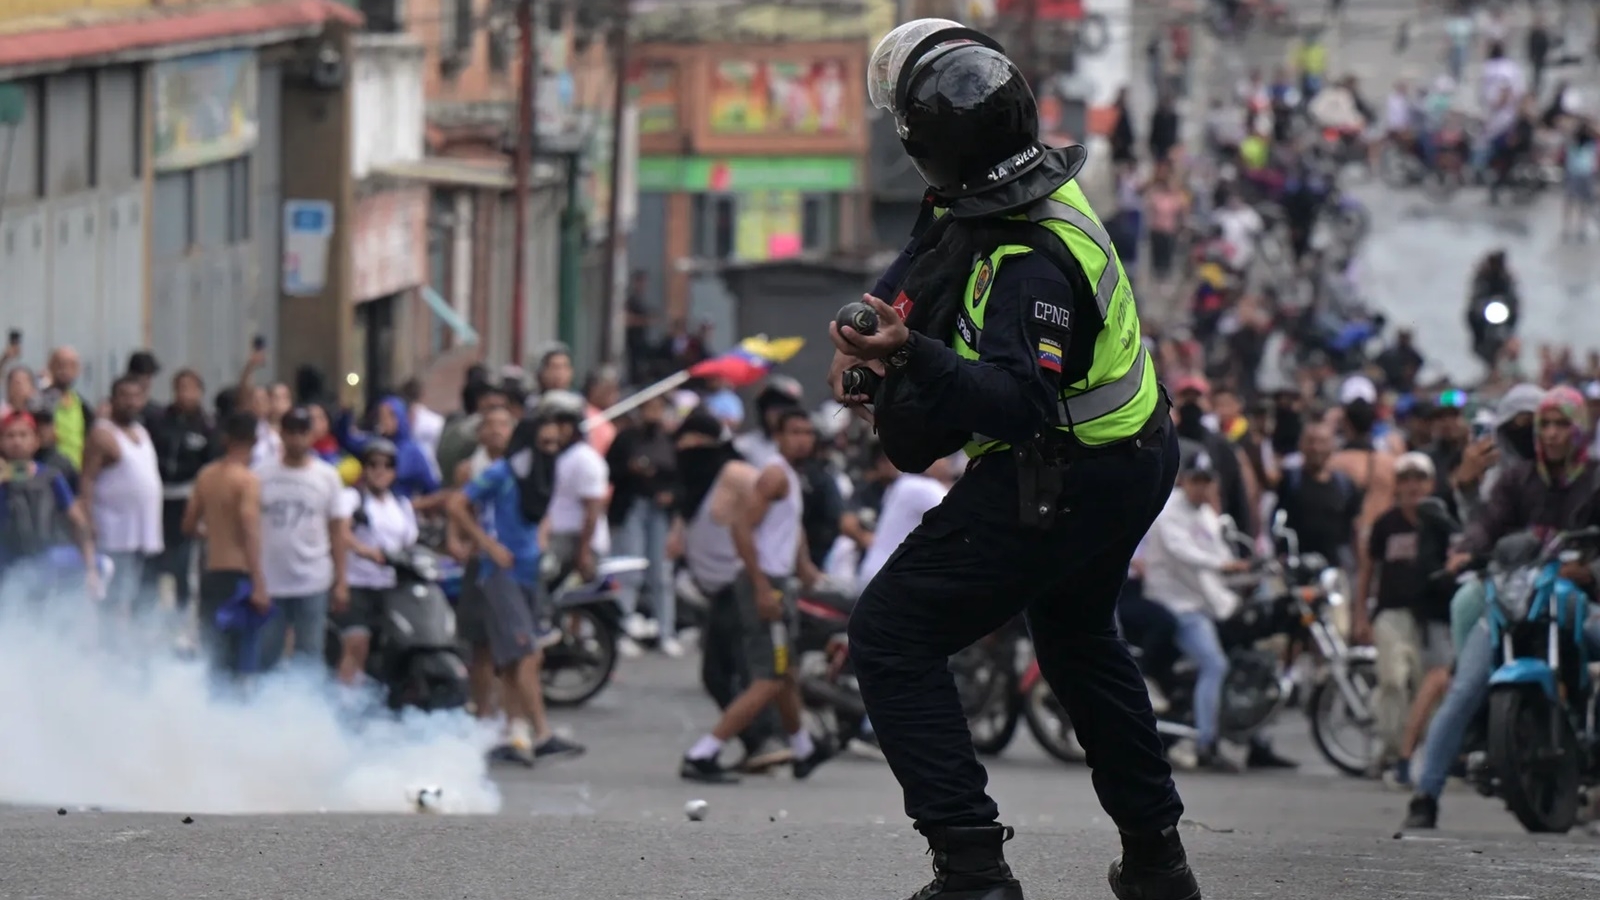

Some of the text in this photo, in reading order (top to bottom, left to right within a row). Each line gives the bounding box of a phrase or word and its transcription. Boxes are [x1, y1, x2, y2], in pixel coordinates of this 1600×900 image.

[990, 146, 1040, 181] LA VEGA
[1035, 301, 1070, 328] CPNB
